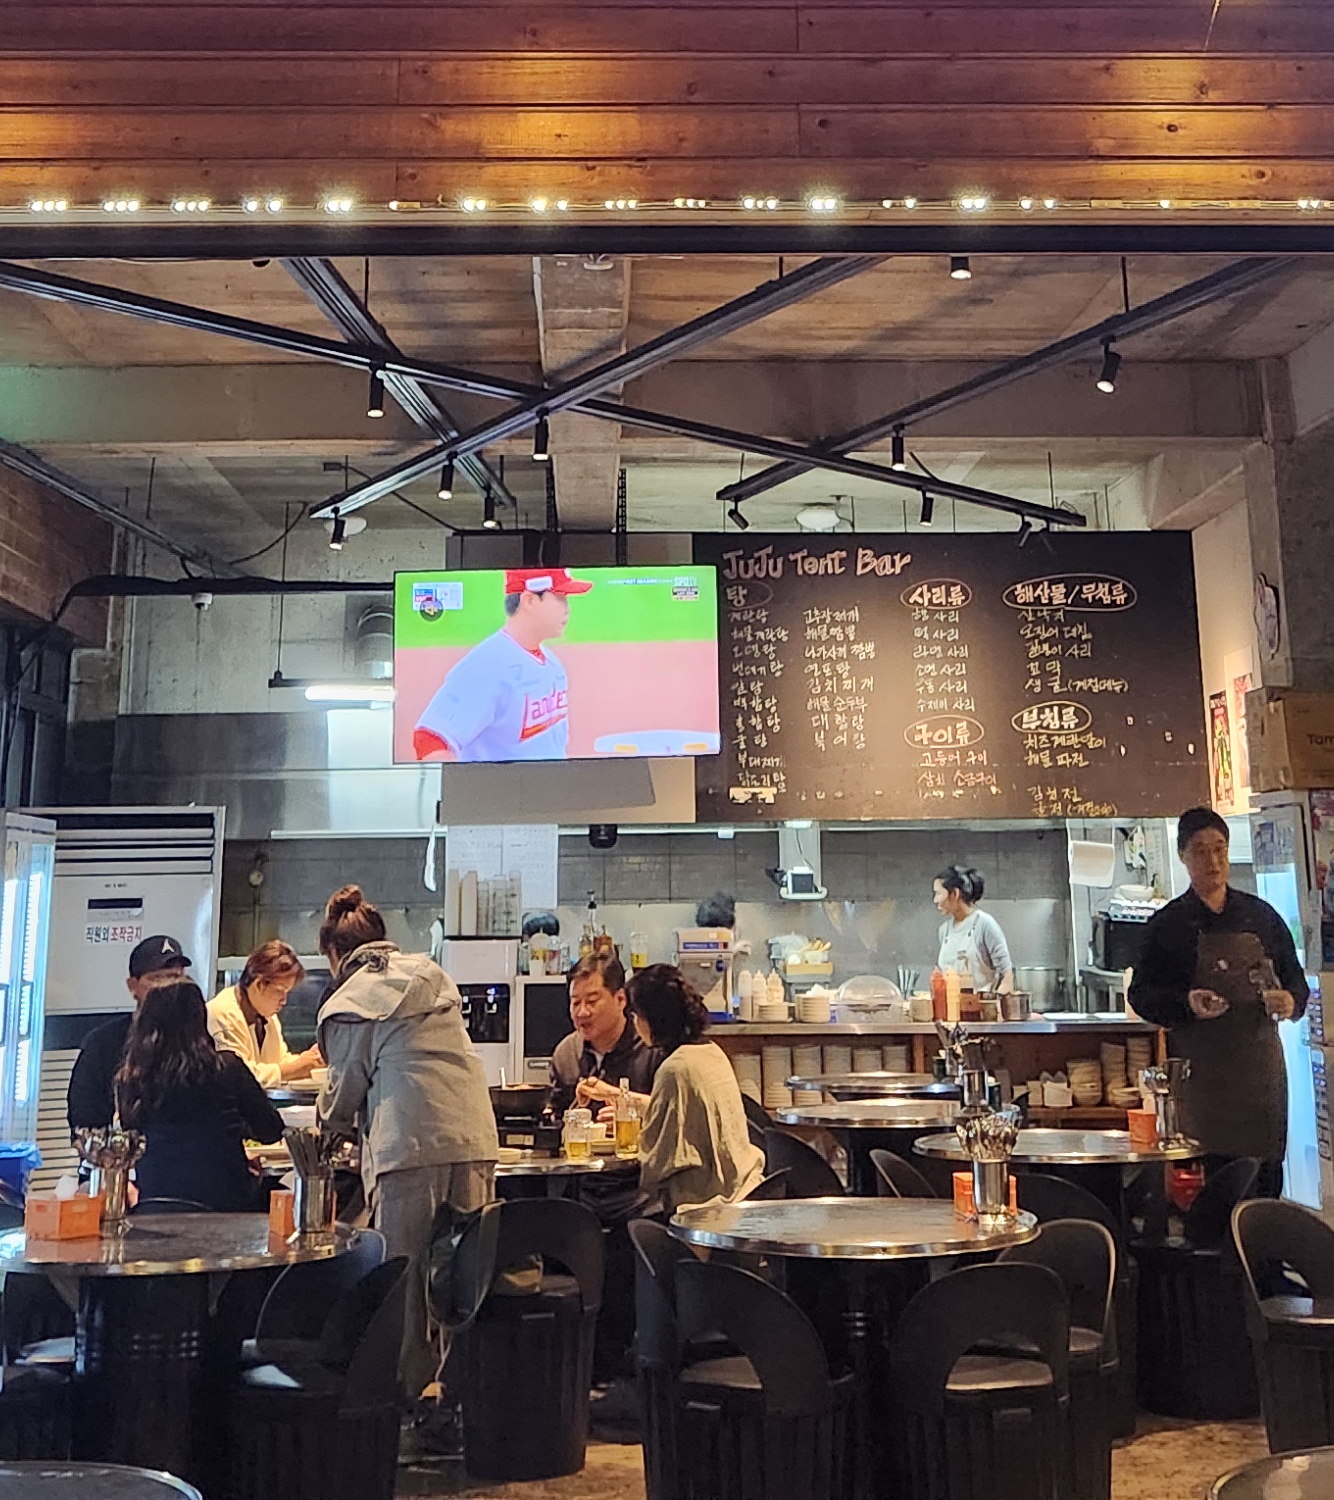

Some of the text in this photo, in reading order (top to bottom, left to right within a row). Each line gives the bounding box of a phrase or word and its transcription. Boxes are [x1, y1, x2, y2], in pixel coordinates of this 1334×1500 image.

[856, 547, 911, 577] Bar
[726, 585, 748, 608] 탕
[909, 584, 966, 607] 사리류
[933, 610, 960, 623] 사리
[932, 628, 959, 641] 사리
[1019, 623, 1059, 639] 오징어
[947, 644, 968, 658] 사리
[1065, 642, 1092, 659] 사리
[940, 662, 967, 676] 사리
[939, 679, 967, 694] 사리
[953, 696, 975, 712] 사리
[1022, 705, 1079, 730] 부침류
[914, 720, 970, 745] 구이류
[920, 749, 988, 767] 고등어 구이
